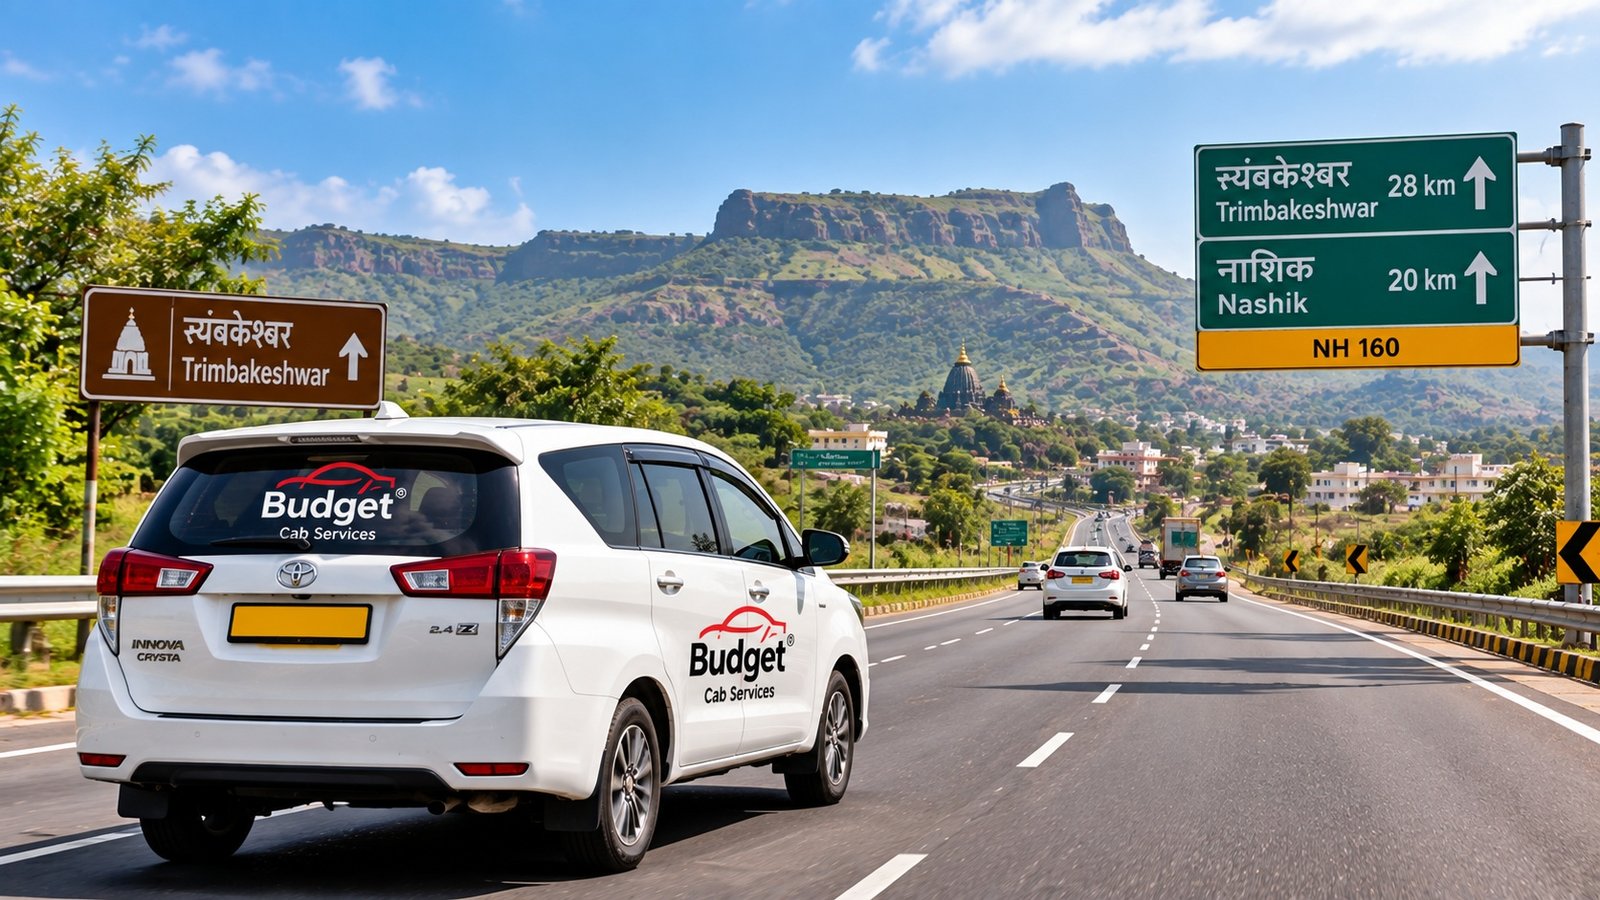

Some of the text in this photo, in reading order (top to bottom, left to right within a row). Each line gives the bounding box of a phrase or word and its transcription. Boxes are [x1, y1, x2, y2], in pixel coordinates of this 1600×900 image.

[1388, 173, 1456, 198] 28 km
[1215, 197, 1379, 222] Trimbakeshwar
[1216, 248, 1316, 283] नाशिक
[1388, 267, 1456, 292] 20 km
[1218, 291, 1309, 315] Nashik
[1313, 337, 1400, 359] NH 160
[181, 356, 330, 387] Trimbakeshwar
[261, 489, 394, 526] Budget
[279, 526, 376, 541] Cab Services
[131, 639, 185, 651] INNOVA
[136, 652, 181, 662] CRYSTA
[689, 638, 786, 682] Budget
[704, 684, 775, 704] Cab Services
